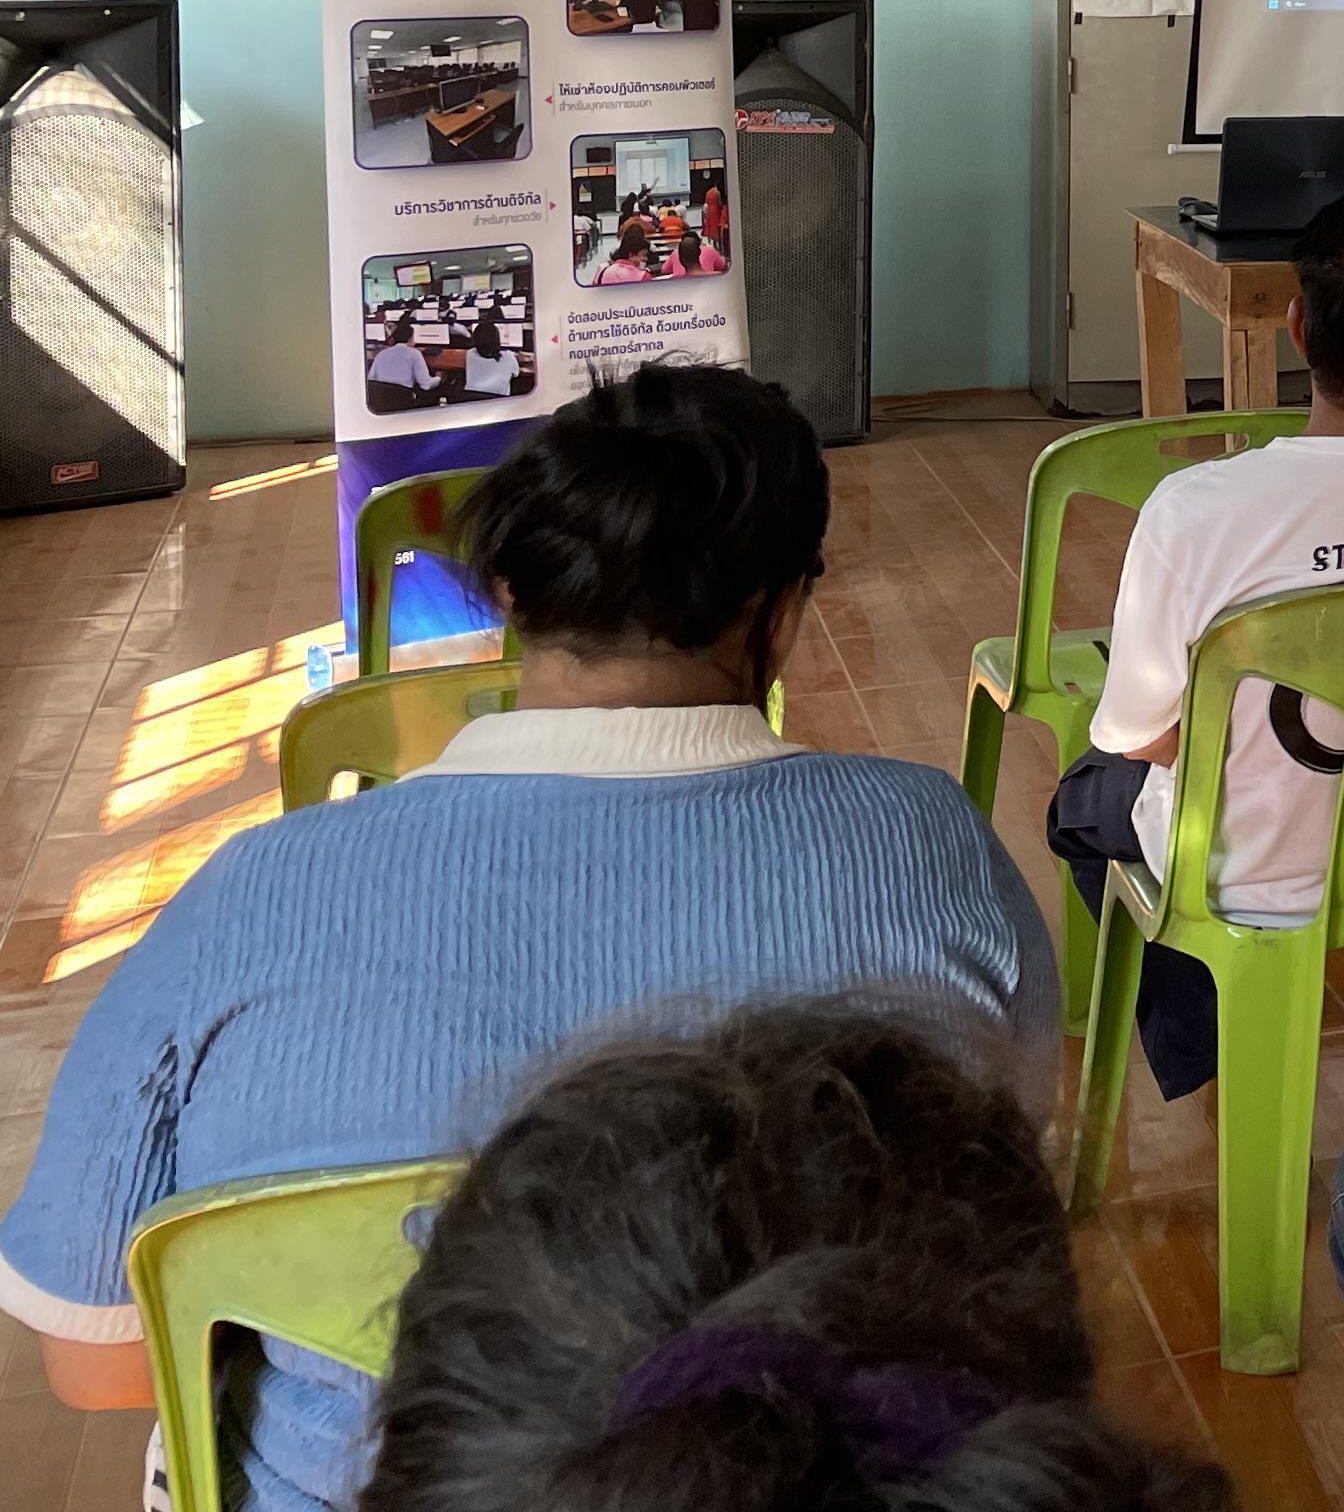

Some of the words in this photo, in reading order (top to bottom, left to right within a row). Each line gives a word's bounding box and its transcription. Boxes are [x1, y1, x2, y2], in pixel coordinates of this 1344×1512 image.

[394, 191, 542, 216] บริการวิชาการด้านดิจิทัล
[567, 302, 694, 325] จัดสอบประเมินสมรรถนะ
[568, 322, 653, 343] ด้านการใช้ดิจิทัล
[656, 313, 726, 333] ด้วยเครื่องมือ
